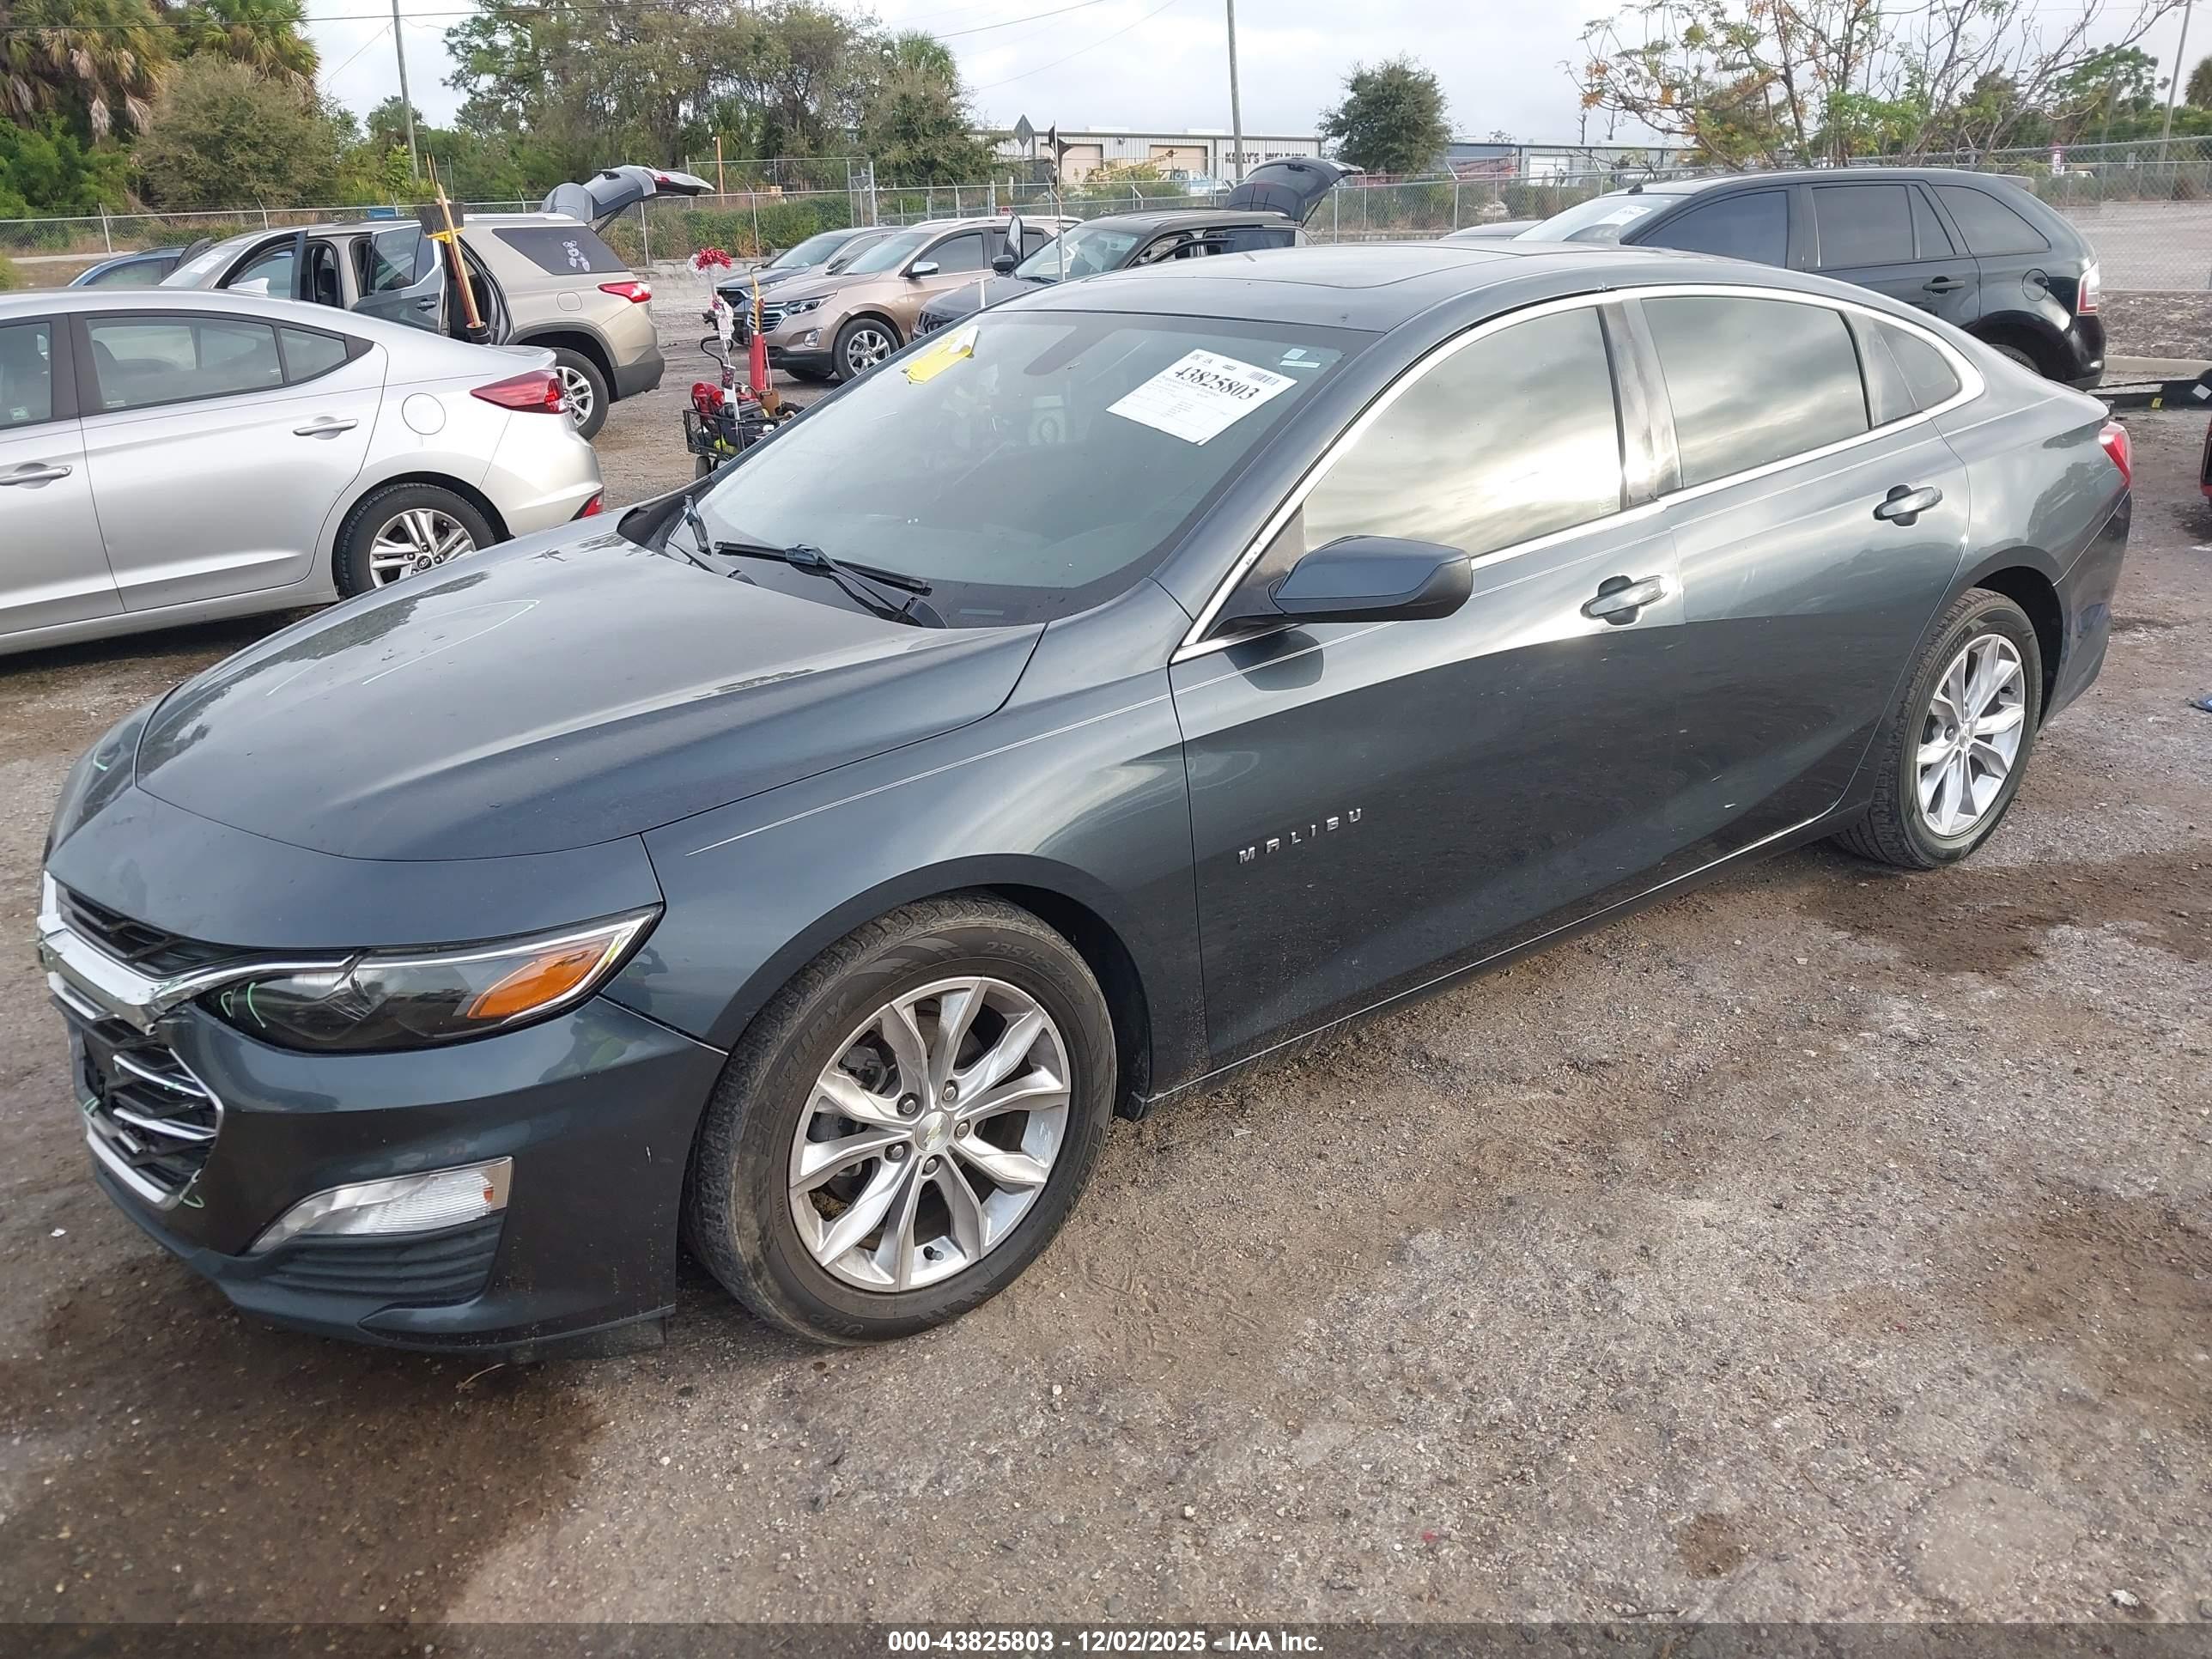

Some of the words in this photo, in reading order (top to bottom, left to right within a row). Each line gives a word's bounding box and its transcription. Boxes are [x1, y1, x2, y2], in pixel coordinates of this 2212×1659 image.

[1224, 152, 1259, 164] KELY'S
[1175, 366, 1260, 399] 43825803
[1238, 808, 1362, 866] MALIBU
